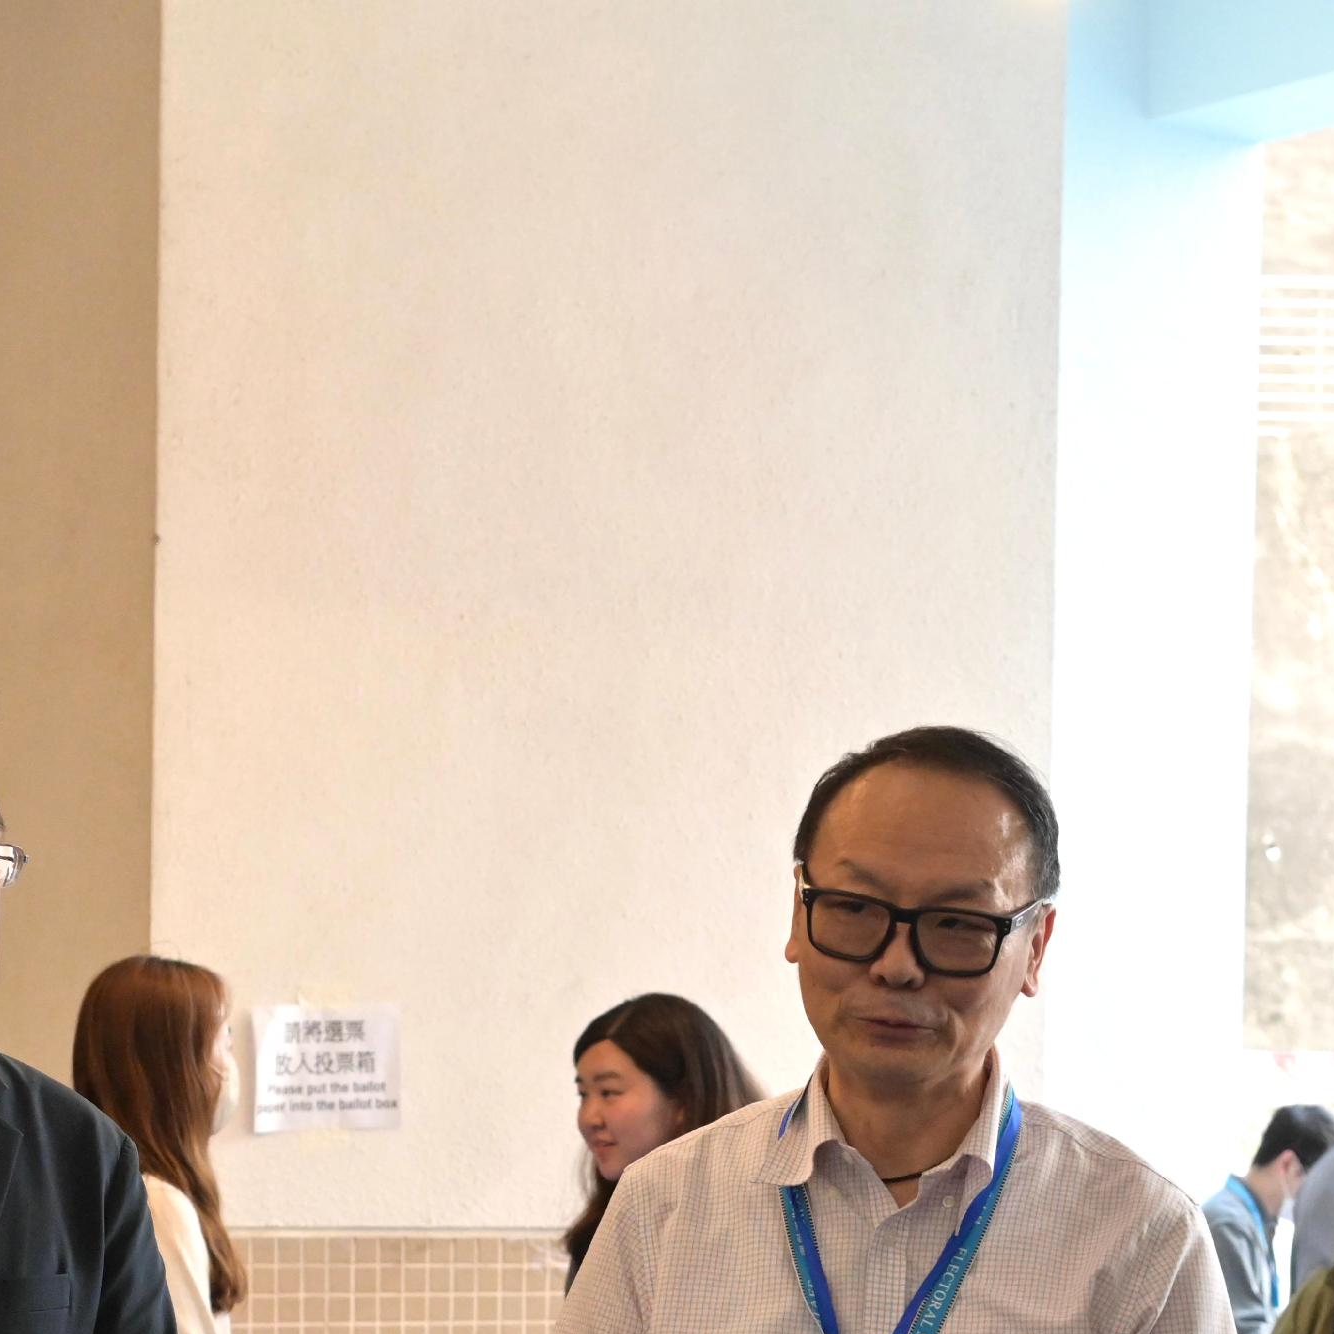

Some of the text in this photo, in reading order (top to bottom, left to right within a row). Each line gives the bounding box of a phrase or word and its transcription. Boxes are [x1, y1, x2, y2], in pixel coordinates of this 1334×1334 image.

[307, 1083, 326, 1096] put
[330, 1082, 349, 1093] the
[353, 1081, 387, 1093] ballot
[289, 1100, 312, 1111] into
[316, 1100, 334, 1110] the
[339, 1098, 371, 1110] ballot
[375, 1099, 398, 1109] box
